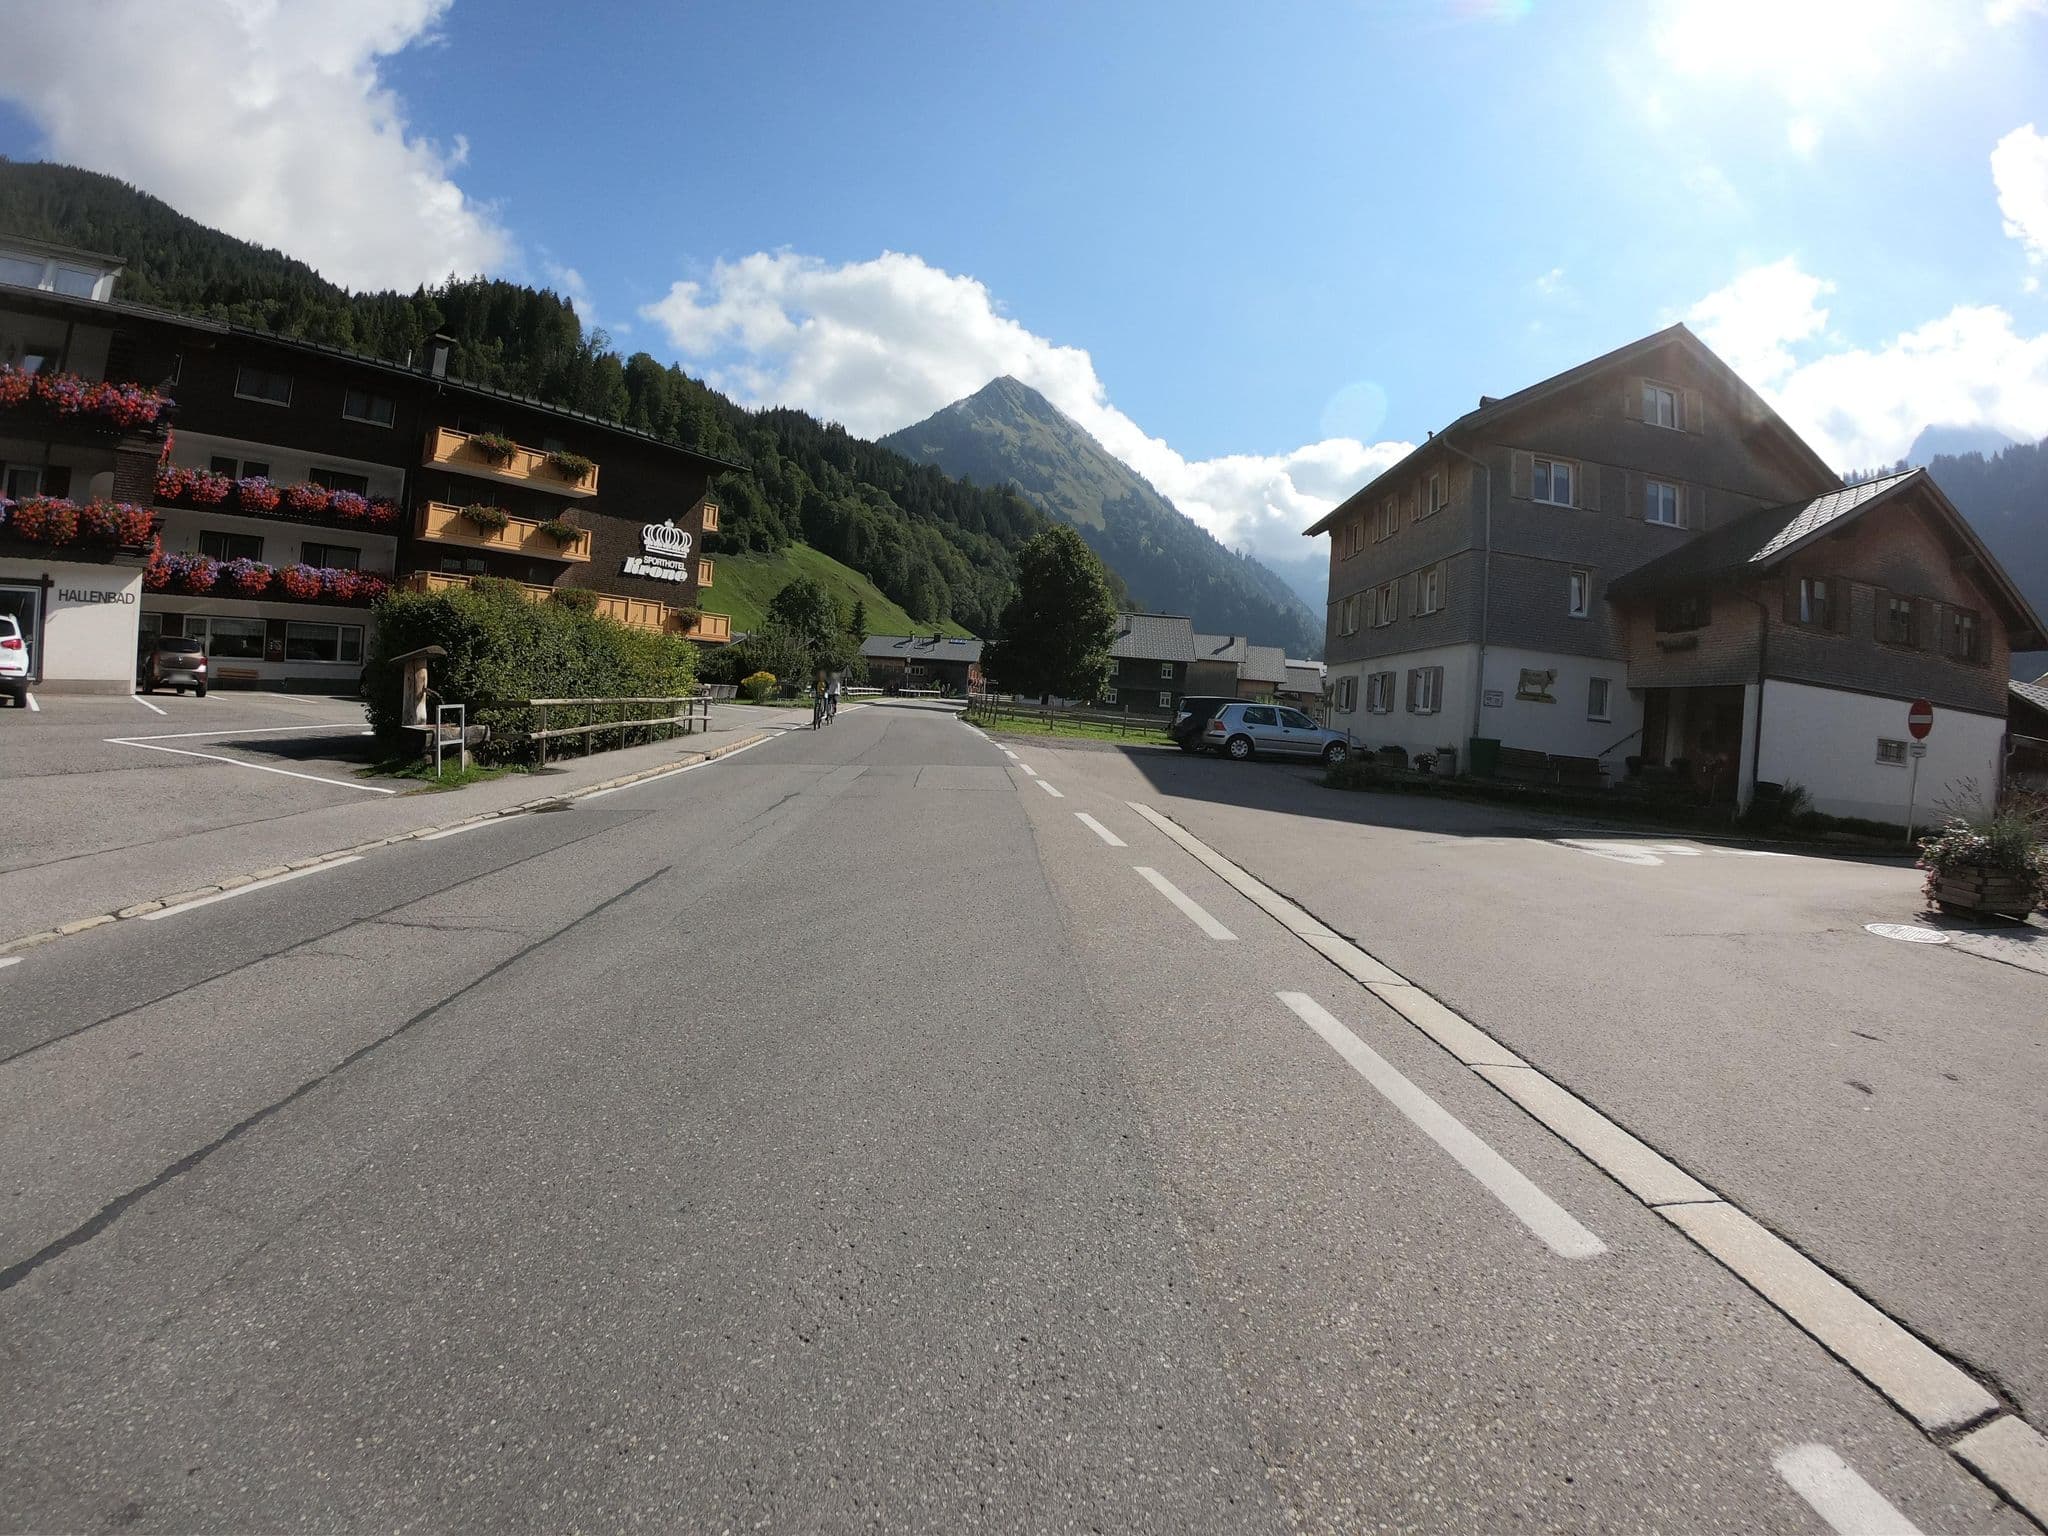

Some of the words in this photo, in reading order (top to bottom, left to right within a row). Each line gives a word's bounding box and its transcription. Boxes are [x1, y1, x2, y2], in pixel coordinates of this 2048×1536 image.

[624, 557, 688, 581] Krone
[644, 556, 686, 570] SPORTHOTEL
[58, 589, 135, 604] HALLENBAD
